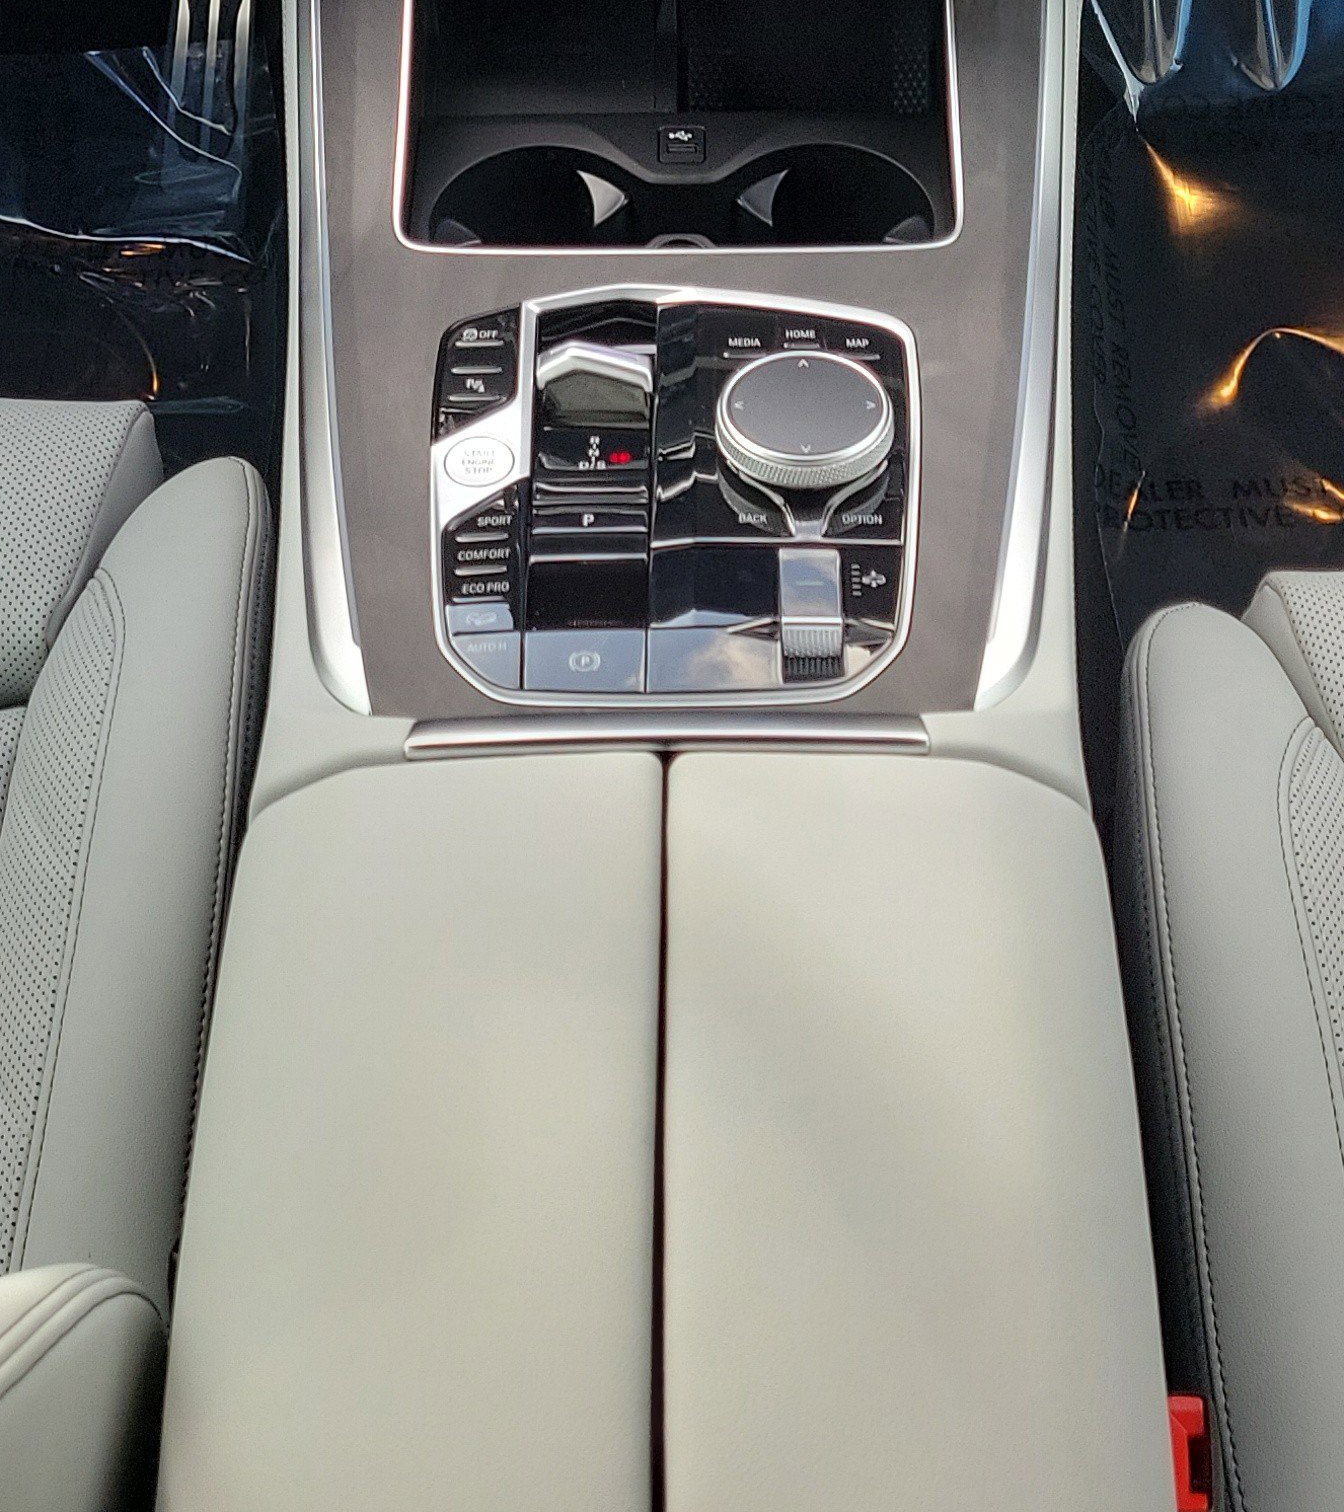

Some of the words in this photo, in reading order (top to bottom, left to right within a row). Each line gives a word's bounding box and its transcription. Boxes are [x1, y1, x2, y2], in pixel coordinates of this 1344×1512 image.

[785, 329, 816, 339] HOME
[728, 338, 761, 348] MEDIA
[846, 339, 869, 348] MAP
[477, 515, 512, 527] SPORT
[582, 514, 595, 527] P
[738, 513, 768, 524] BACK
[842, 514, 882, 525] OPTION
[457, 548, 510, 561] COMFORT
[462, 583, 485, 594] ECO
[486, 581, 510, 593] PRO
